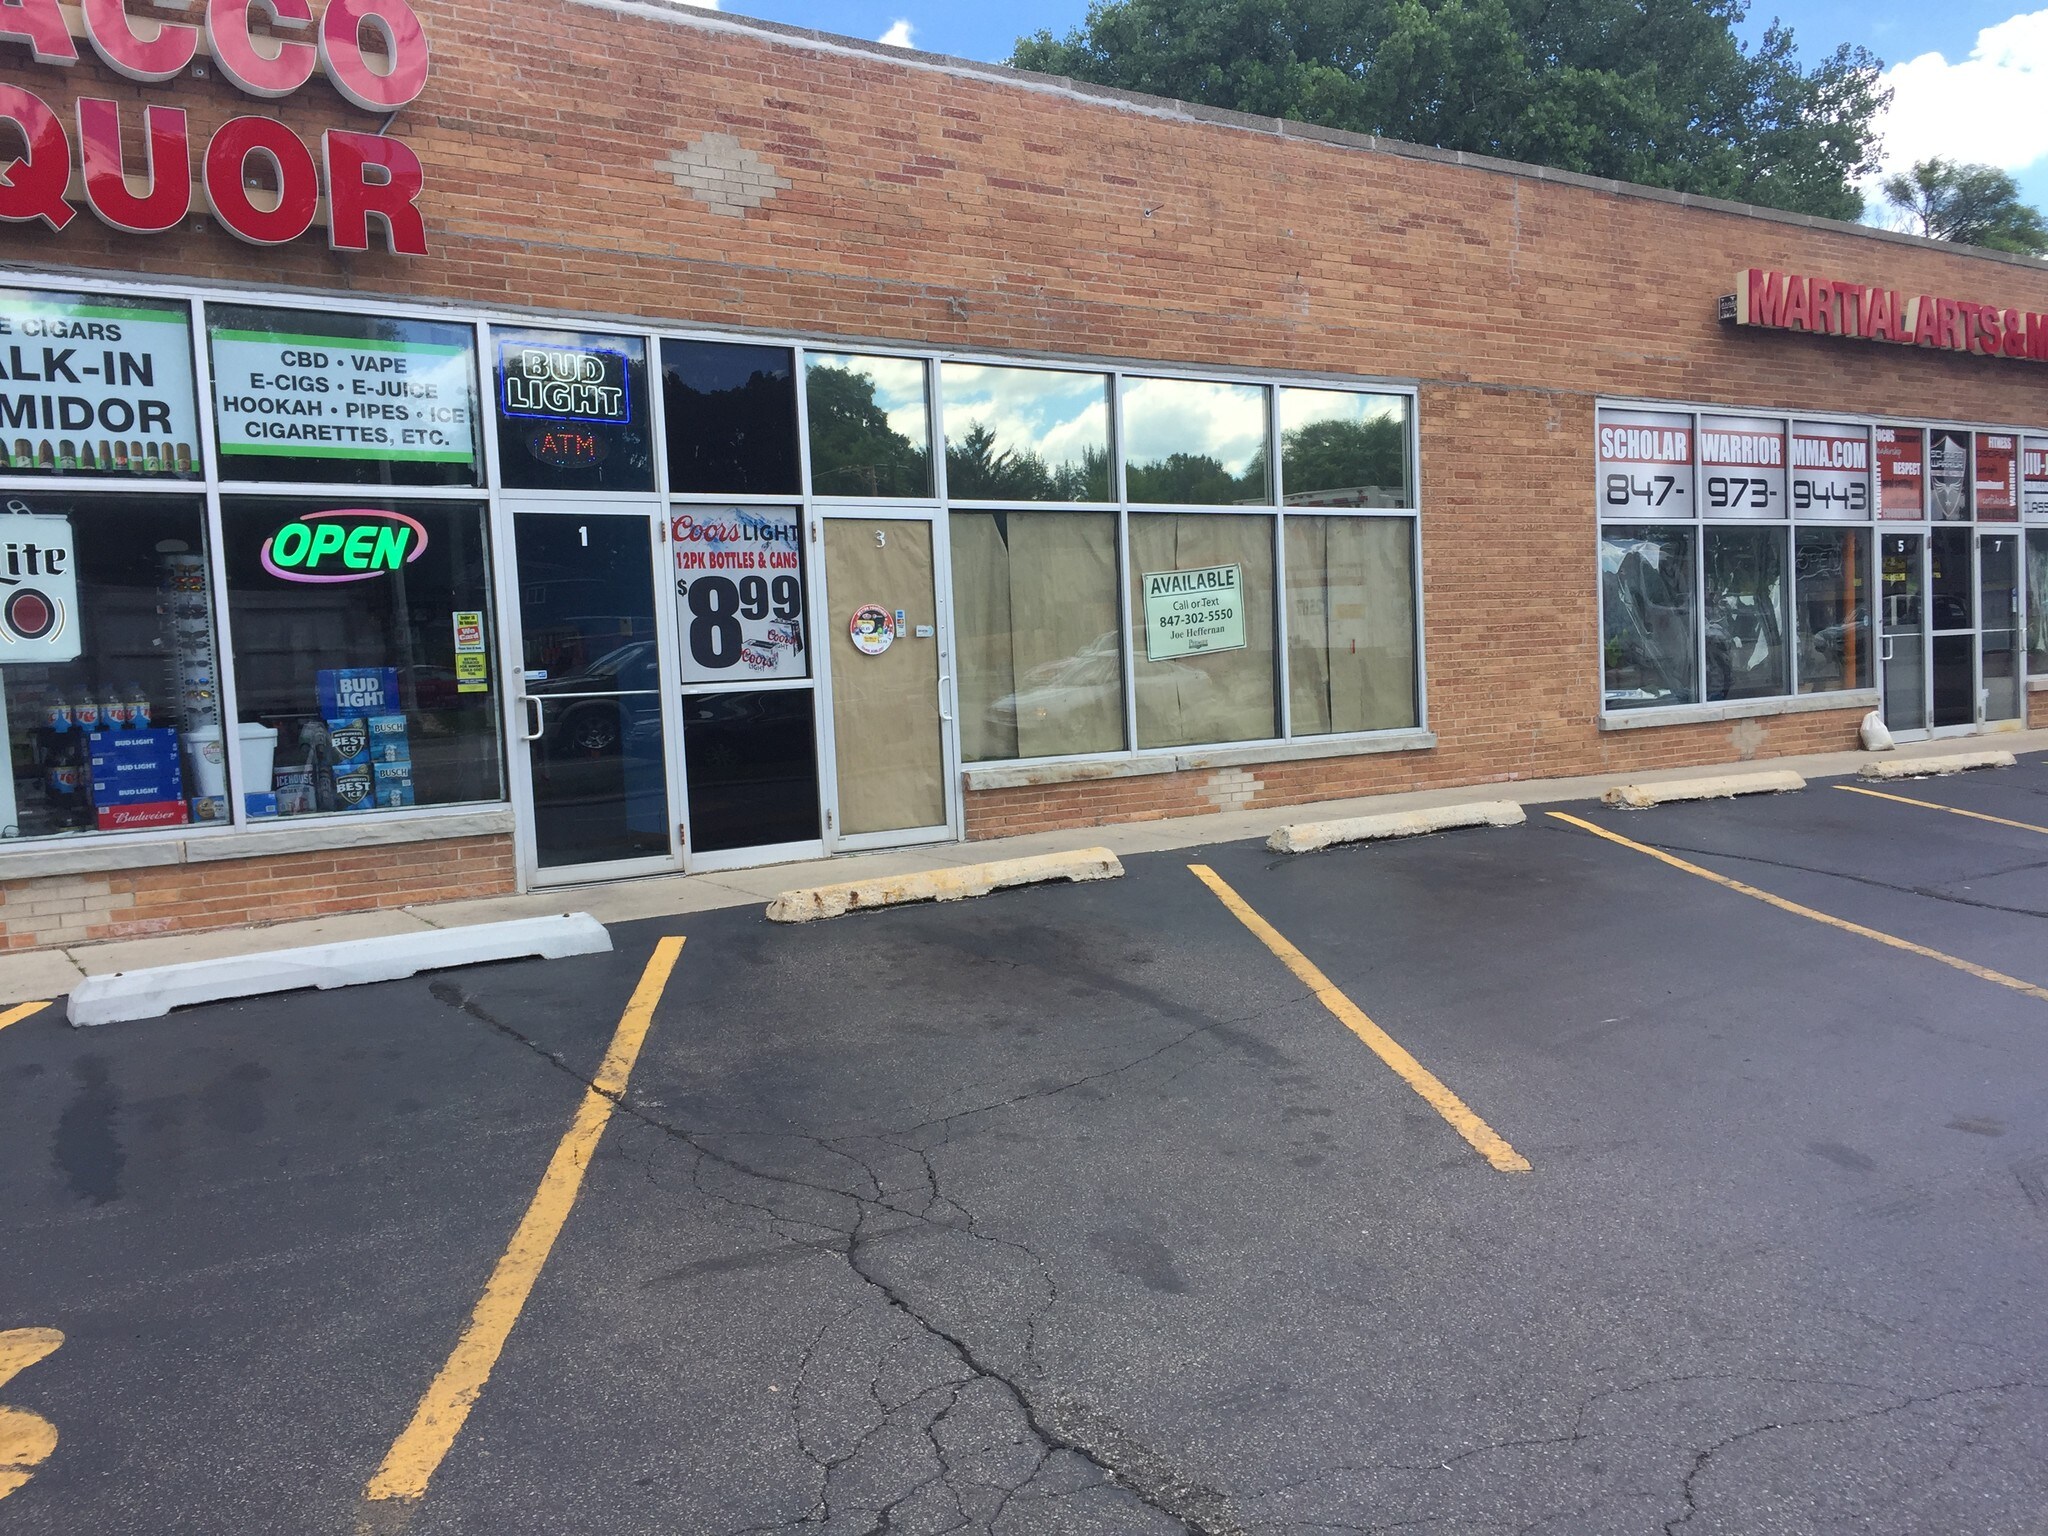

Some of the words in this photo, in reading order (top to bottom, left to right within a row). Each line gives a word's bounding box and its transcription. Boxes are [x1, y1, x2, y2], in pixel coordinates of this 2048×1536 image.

[1749, 268, 1913, 343] MARTIAL
[1914, 295, 2001, 355] ARTS
[21, 318, 122, 342] CIGARS
[0, 346, 154, 387] LK-IN
[280, 350, 329, 369] CBD
[350, 355, 407, 374] VAPE
[522, 350, 605, 384] BUD
[250, 373, 329, 393] E-CIGS
[352, 379, 438, 399] E-JUICE
[508, 377, 622, 416] LIGHT
[224, 396, 322, 417] HOOKAH
[346, 403, 409, 421] PIPES
[431, 407, 465, 423] ICE
[245, 422, 395, 447] CIGARETTES,
[402, 429, 450, 446] ETC.
[542, 433, 595, 455] ATM
[1601, 427, 1687, 461] SCHOLAR
[1702, 433, 1781, 465] WARRIOR
[1793, 438, 1867, 469] MMA.COM
[1893, 462, 1921, 475] RESPECT
[2025, 452, 2048, 476] JIU-
[1606, 474, 1684, 507] 847-
[1708, 477, 1777, 507] 973-
[1793, 480, 1867, 510] 9443
[578, 526, 589, 546] 1
[671, 515, 741, 542] Coors
[743, 524, 799, 541] LIGHT
[875, 529, 886, 548] 3
[272, 523, 410, 570] OPEN
[1898, 540, 1905, 552] 5
[1995, 540, 2002, 552] 7
[0, 543, 67, 583] ite
[676, 552, 706, 569] 12PK
[709, 552, 755, 569] BOTTLES
[758, 552, 767, 568] &
[770, 552, 798, 569] CANS
[1151, 569, 1234, 594] AVAILABLE
[1173, 600, 1189, 611] Call
[1191, 600, 1201, 609] or
[1201, 597, 1220, 607] Text
[1160, 608, 1233, 628] 847-302-5550
[1170, 630, 1184, 640] Joe
[1186, 626, 1225, 638] Heffernan
[340, 678, 379, 693] BUD
[336, 691, 384, 707] LIGHT
[374, 723, 403, 733] BUSCH
[332, 737, 366, 747] BEST
[134, 762, 157, 770] LIGHT
[380, 768, 408, 778] BUSCH
[136, 787, 158, 795] LIGHT
[276, 773, 314, 787] ICEHOUSE
[336, 782, 371, 793] BEST
[112, 811, 174, 824] Budweiser
